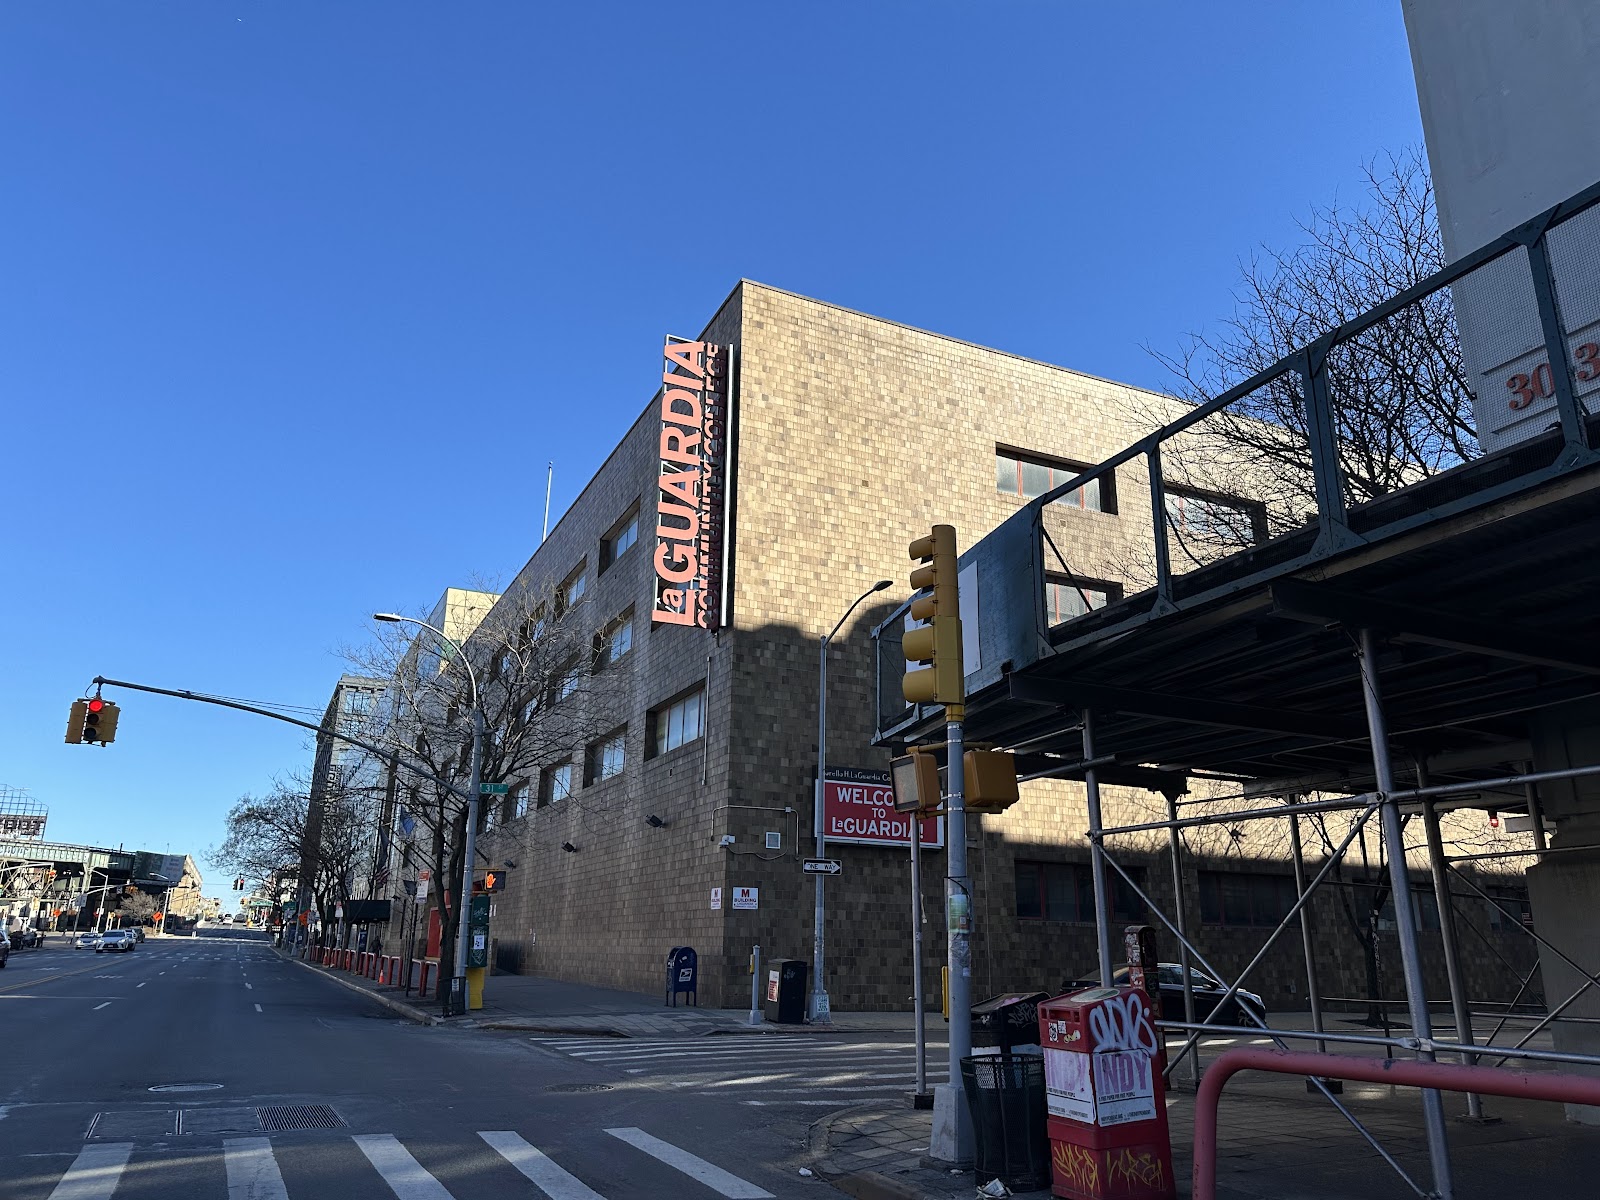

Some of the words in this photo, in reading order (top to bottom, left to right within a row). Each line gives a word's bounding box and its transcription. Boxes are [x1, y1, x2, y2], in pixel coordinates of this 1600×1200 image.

[652, 340, 705, 627] LaGUARDIA
[850, 770, 881, 781] LaGuardia
[485, 784, 494, 793] 31
[836, 786, 894, 807] WELCO
[871, 807, 887, 819] TO
[741, 888, 750, 897] M
[1095, 1051, 1148, 1096] INDY
